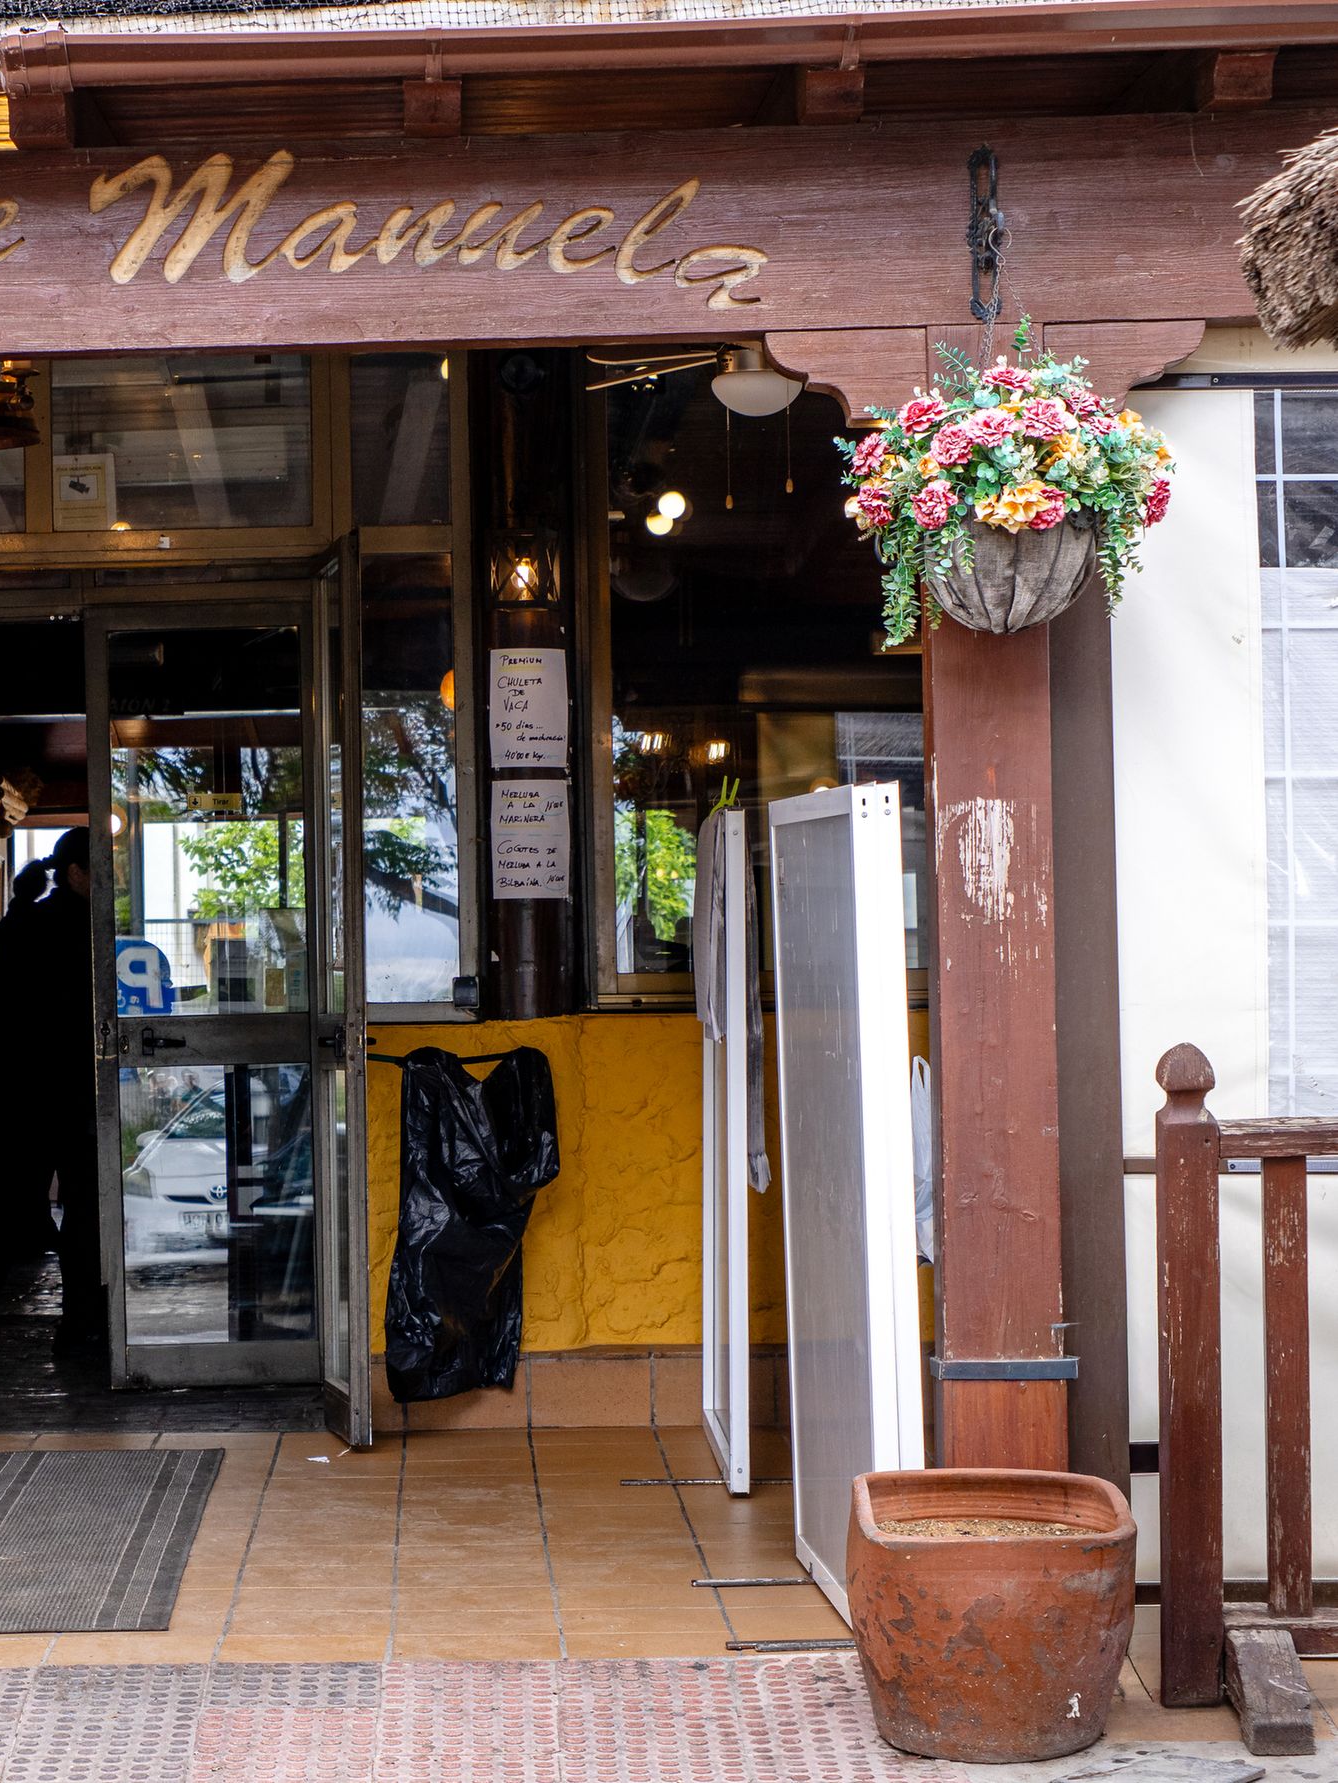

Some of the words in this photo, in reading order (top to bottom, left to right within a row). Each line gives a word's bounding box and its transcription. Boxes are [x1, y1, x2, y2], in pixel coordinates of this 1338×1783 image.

[89, 148, 769, 311] Manuela
[497, 676, 543, 689] CHULETA
[503, 697, 529, 713] VACA
[507, 801, 514, 810] A
[523, 801, 536, 809] LA
[536, 860, 542, 869] A
[546, 860, 557, 868] LA
